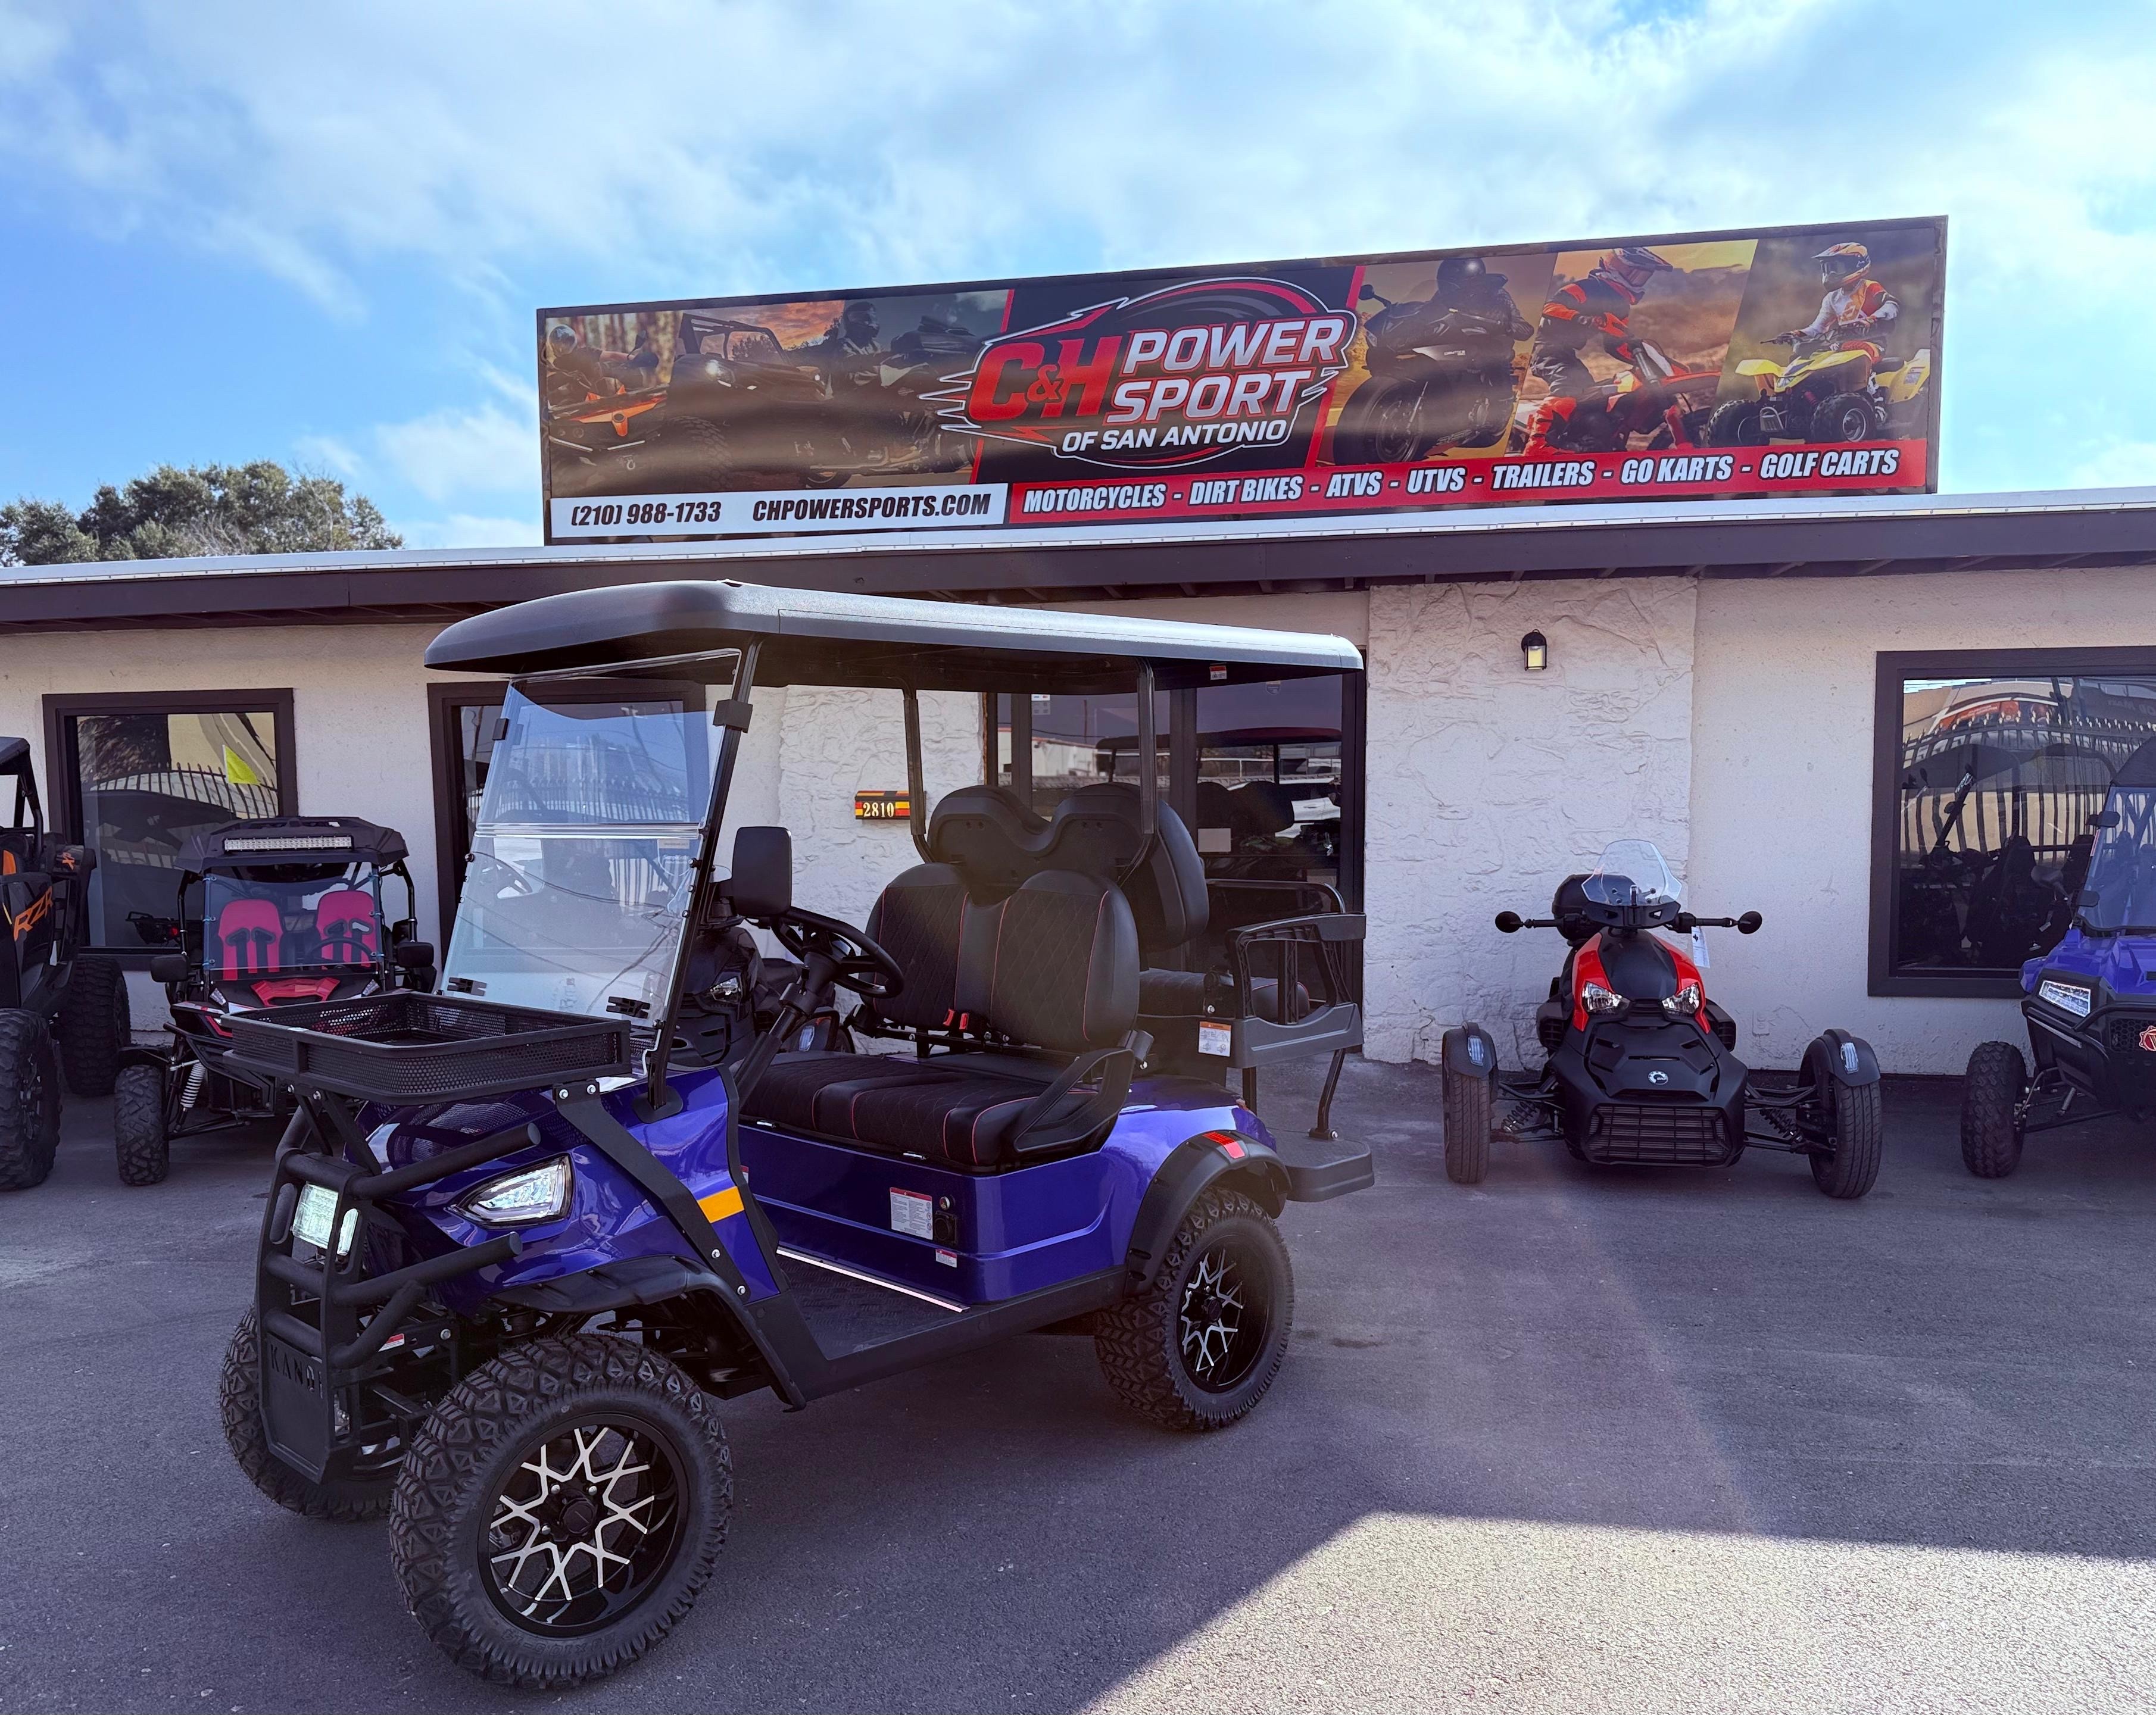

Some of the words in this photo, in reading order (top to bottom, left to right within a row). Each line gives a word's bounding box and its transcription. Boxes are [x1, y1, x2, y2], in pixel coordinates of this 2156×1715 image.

[1121, 317, 1346, 375] POWER
[969, 336, 1123, 421] C&H
[1104, 369, 1313, 424] SPORT
[1062, 431, 1099, 452] OF
[1100, 427, 1157, 450] SAN
[1159, 420, 1287, 446] ANTONIO
[753, 493, 991, 521] CHPOWERSPORTS.COM
[1023, 484, 1166, 513] MOTORCYCLES
[1190, 481, 1240, 505] DIRT
[1241, 476, 1303, 502] BIKES
[1326, 471, 1382, 498] ATVS
[1407, 467, 1466, 493] UTVS
[1492, 461, 1595, 489] TRAILERS
[1621, 458, 1654, 483] GO
[1656, 455, 1734, 482] KARTS
[1760, 451, 1820, 479] GOLF
[1820, 449, 1899, 477] CARTS
[571, 505, 623, 526] (210)
[626, 501, 722, 524] 988-1733
[863, 802, 894, 818] 2810
[13, 885, 54, 941] RZR
[270, 1344, 323, 1400] KANDI
